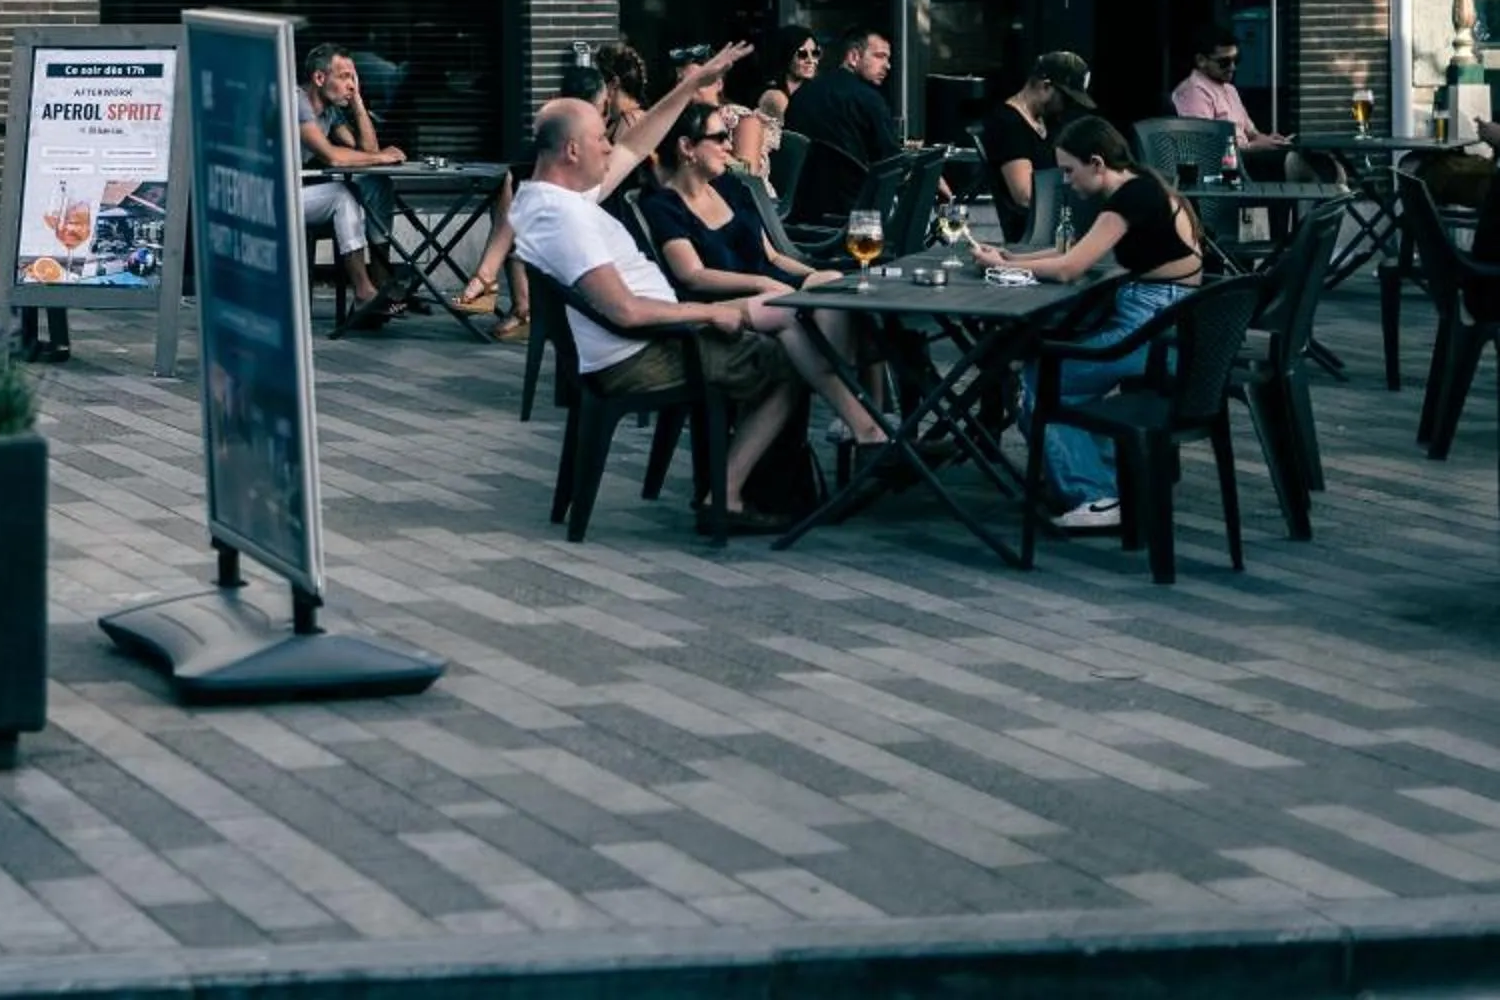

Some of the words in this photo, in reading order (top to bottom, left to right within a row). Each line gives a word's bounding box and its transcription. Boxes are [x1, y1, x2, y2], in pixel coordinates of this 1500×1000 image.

[64, 65, 79, 75] Ce
[80, 65, 103, 75] soir
[126, 65, 146, 76] 17h
[73, 87, 134, 98] AFTERWORK
[41, 103, 103, 121] APEROL
[106, 103, 163, 121] SPRITZ
